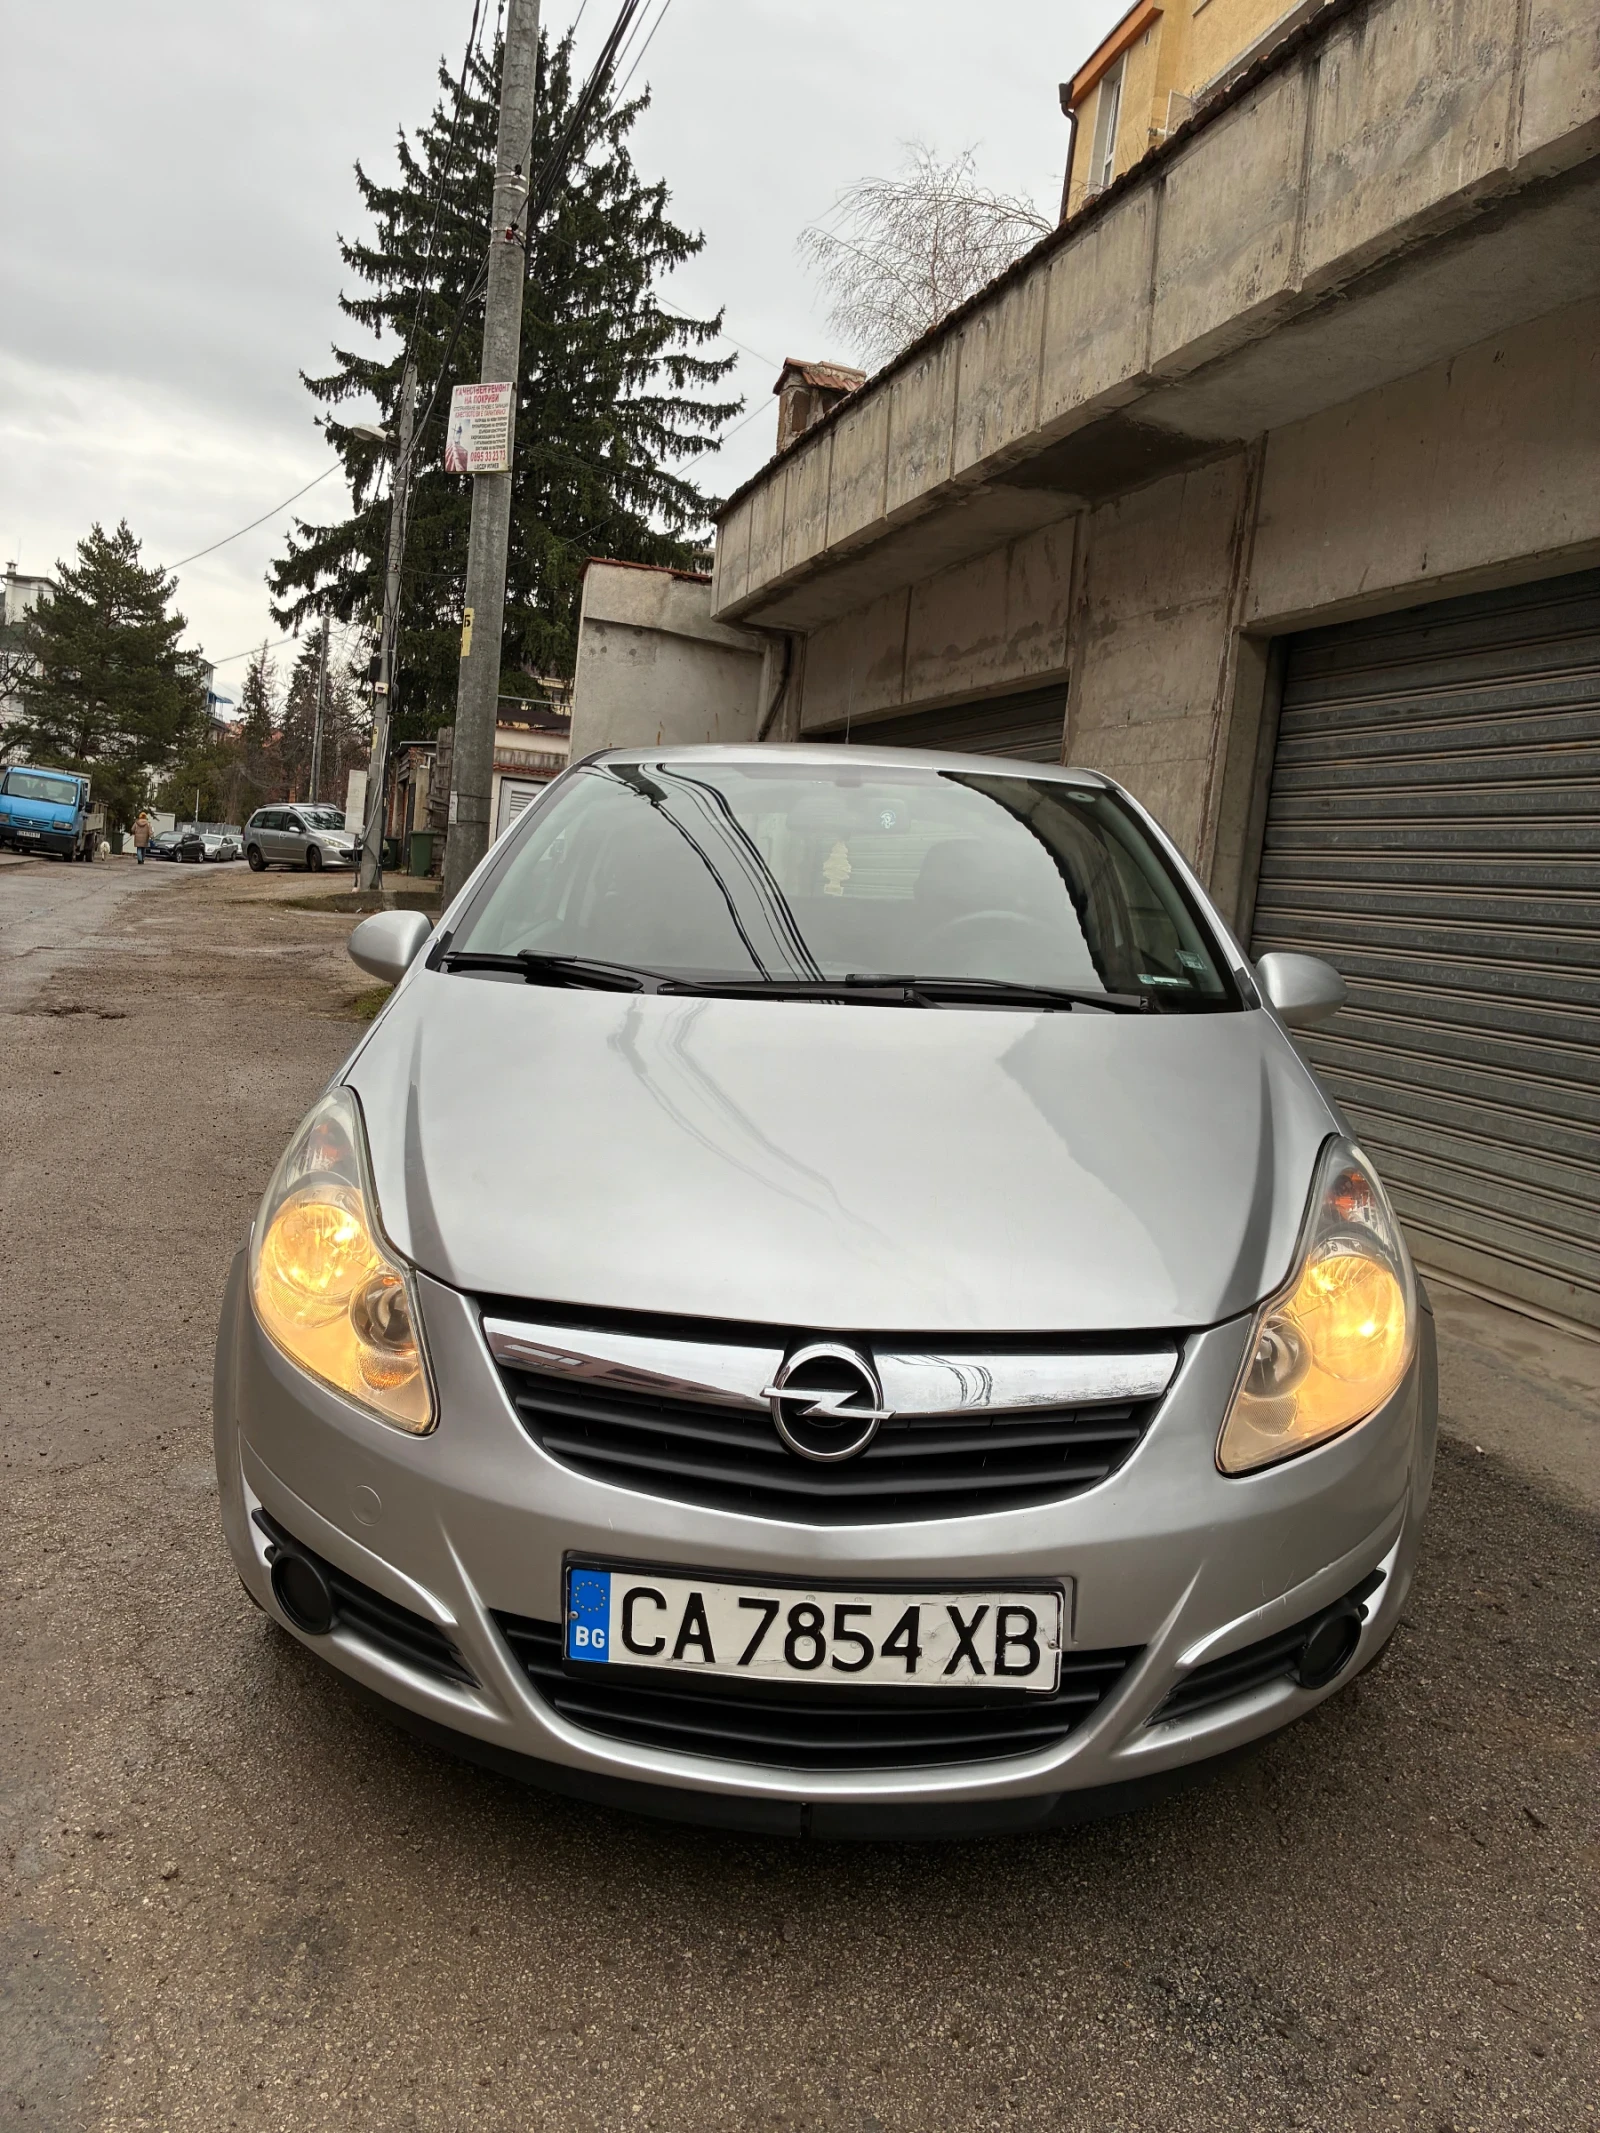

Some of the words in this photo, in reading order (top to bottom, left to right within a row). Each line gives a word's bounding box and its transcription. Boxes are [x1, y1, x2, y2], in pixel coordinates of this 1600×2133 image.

[455, 386, 487, 396] КАЧЕСТВЕН
[488, 384, 510, 394] РЕМОНТ
[464, 396, 472, 404] НА
[473, 394, 500, 404] ПОКРИВИ
[576, 1625, 605, 1649] BG
[622, 1587, 716, 1663] CA
[737, 1597, 922, 1673] 7854
[943, 1604, 1041, 1676] XB
